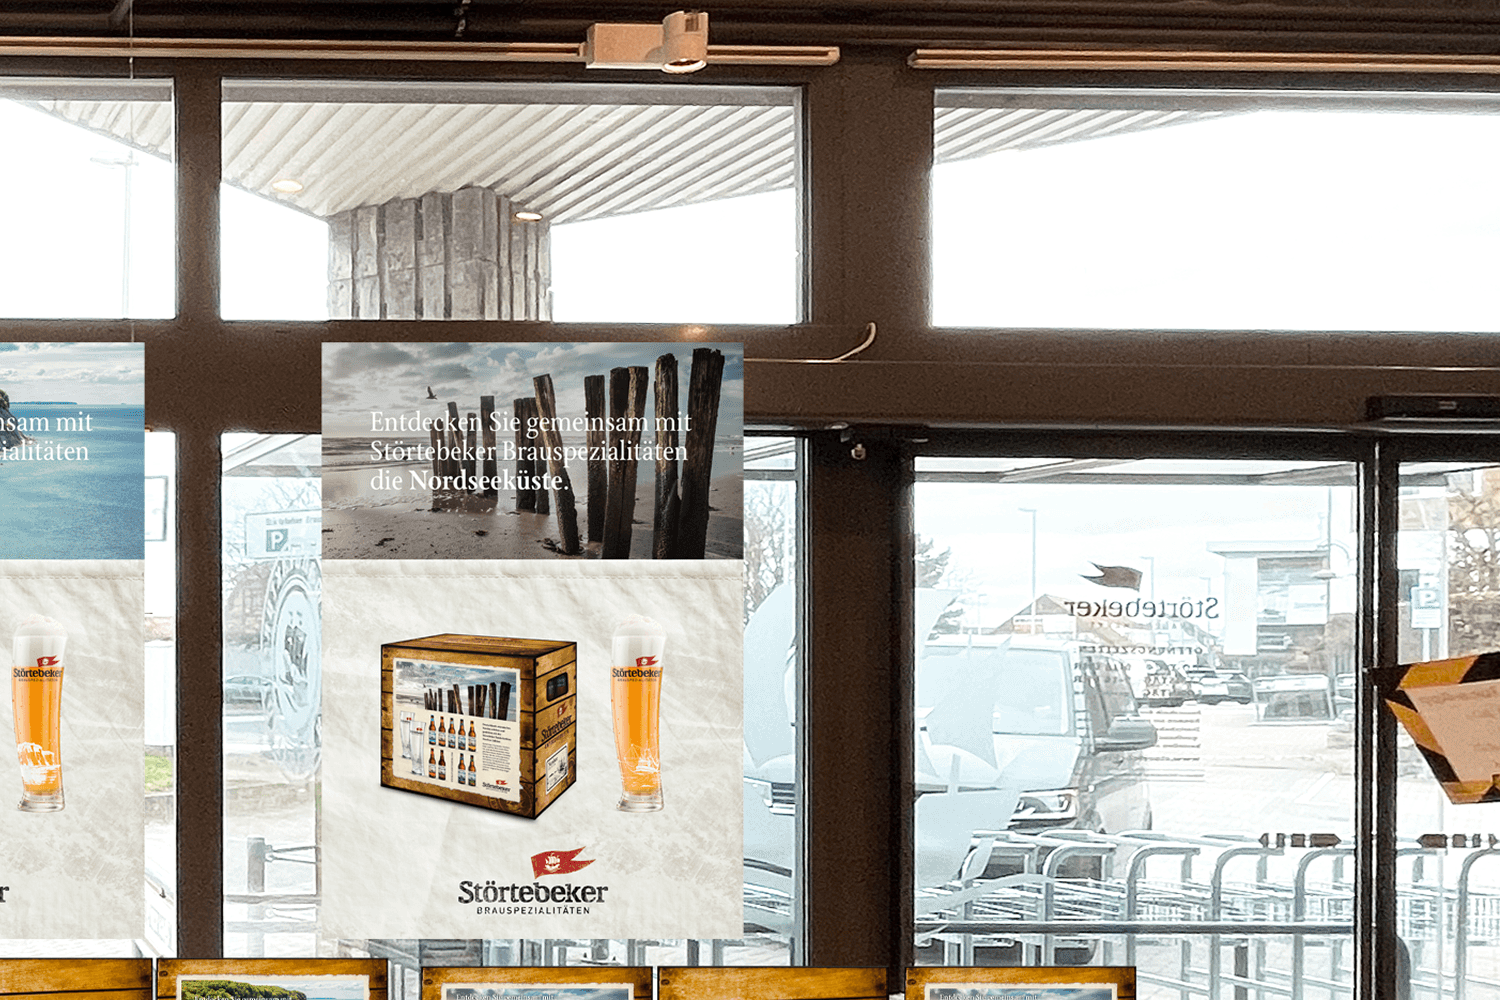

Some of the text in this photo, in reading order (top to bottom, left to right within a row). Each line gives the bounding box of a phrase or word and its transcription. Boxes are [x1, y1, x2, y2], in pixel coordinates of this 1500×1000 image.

[56, 411, 93, 433] mit
[370, 411, 692, 438] Entdecken Sie gemeinsam mit
[370, 440, 688, 468] Störtebeker Brauspezialitäten
[370, 469, 569, 491] die Nordseeküste.
[12, 668, 63, 679] Störtebeker
[611, 668, 662, 679] Störtebeker
[457, 880, 608, 904] Störtebeker
[476, 903, 590, 915] BRAUSPEZIALITÄTEN
